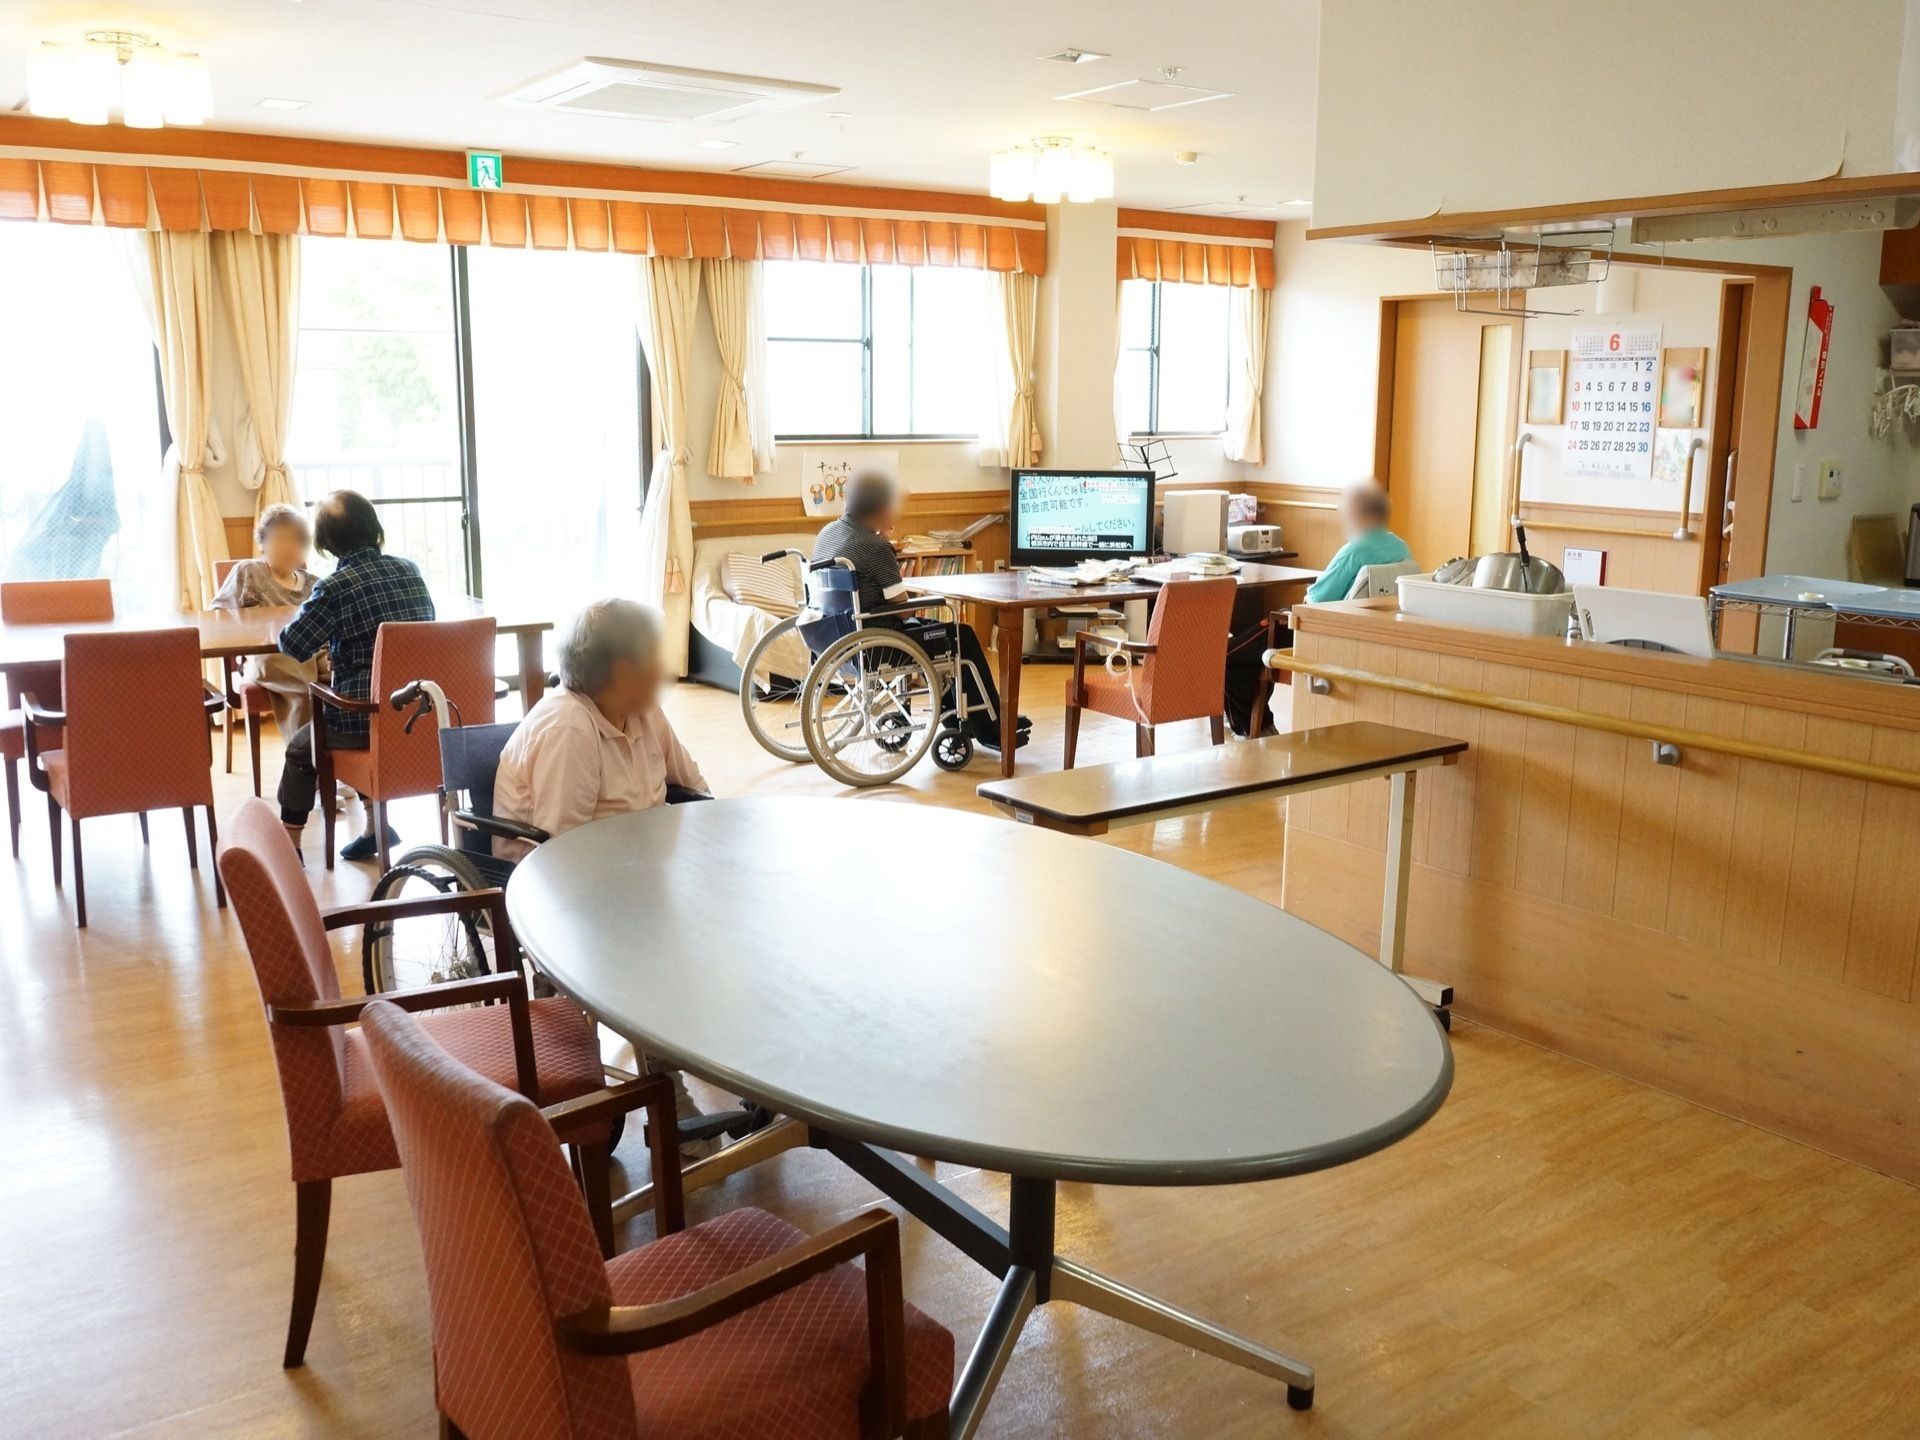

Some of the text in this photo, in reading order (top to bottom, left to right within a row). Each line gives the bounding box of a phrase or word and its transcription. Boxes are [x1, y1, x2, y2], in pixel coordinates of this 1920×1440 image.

[1609, 334, 1620, 351] 6
[1572, 400, 1650, 412] 10 11 12 13 14 15 16
[1570, 420, 1650, 432] 17 18 19 20 21 22 23
[1568, 440, 1648, 452] 24 25 26 27 28 29 30
